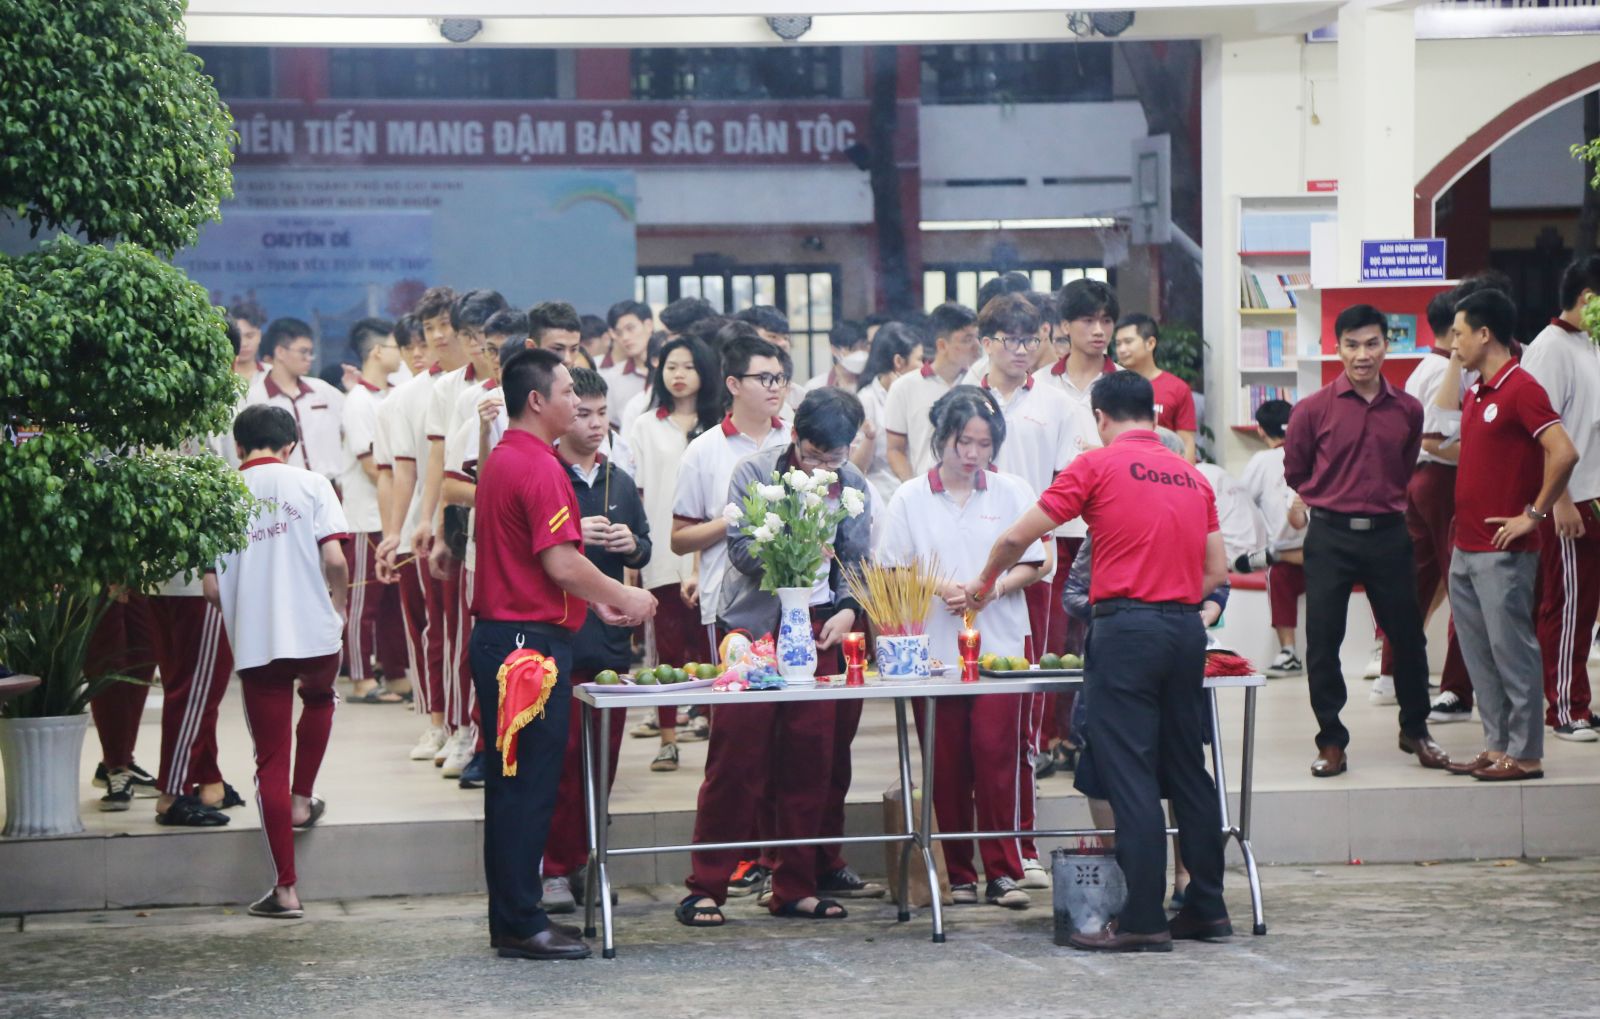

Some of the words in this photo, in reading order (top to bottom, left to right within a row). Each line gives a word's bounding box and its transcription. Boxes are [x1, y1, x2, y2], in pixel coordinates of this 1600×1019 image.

[303, 109, 377, 154] TIẾN
[387, 120, 484, 154] MANG
[493, 113, 566, 162] ĐẬM
[575, 109, 642, 154] BẢN
[651, 108, 715, 154] SẮC
[723, 113, 789, 154] DÂN
[797, 113, 856, 161] TỘC
[1130, 462, 1198, 490] Coach
[281, 500, 302, 521] THPT
